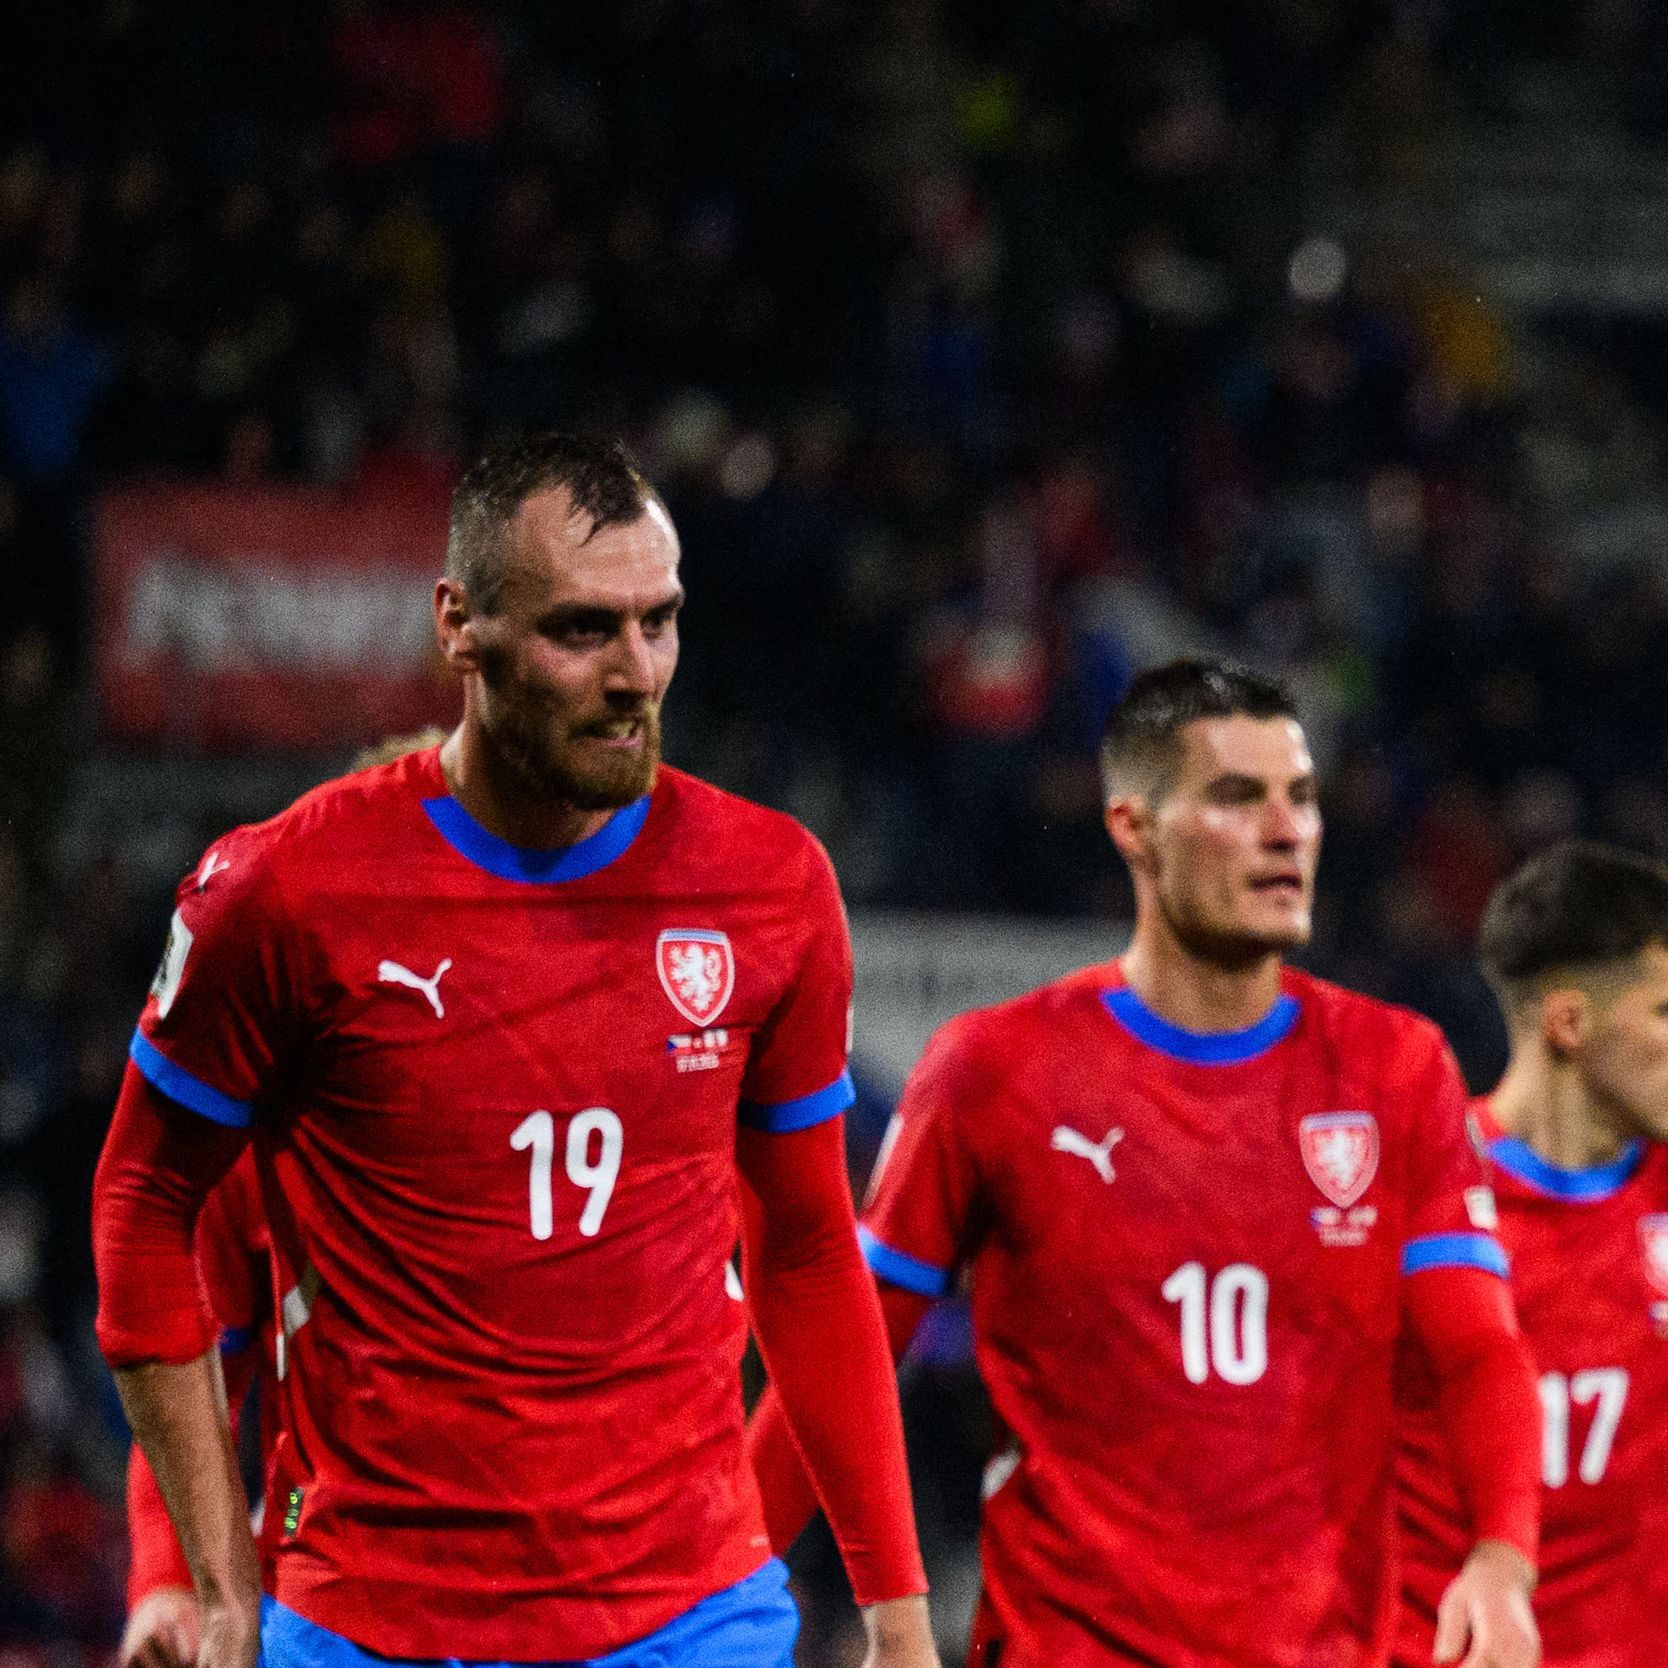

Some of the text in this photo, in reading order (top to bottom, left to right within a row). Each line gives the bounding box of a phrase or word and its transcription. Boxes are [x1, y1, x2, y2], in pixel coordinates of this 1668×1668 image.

[510, 1108, 624, 1241] 19
[1161, 1260, 1269, 1386] 10
[1537, 1366, 1630, 1490] 17
